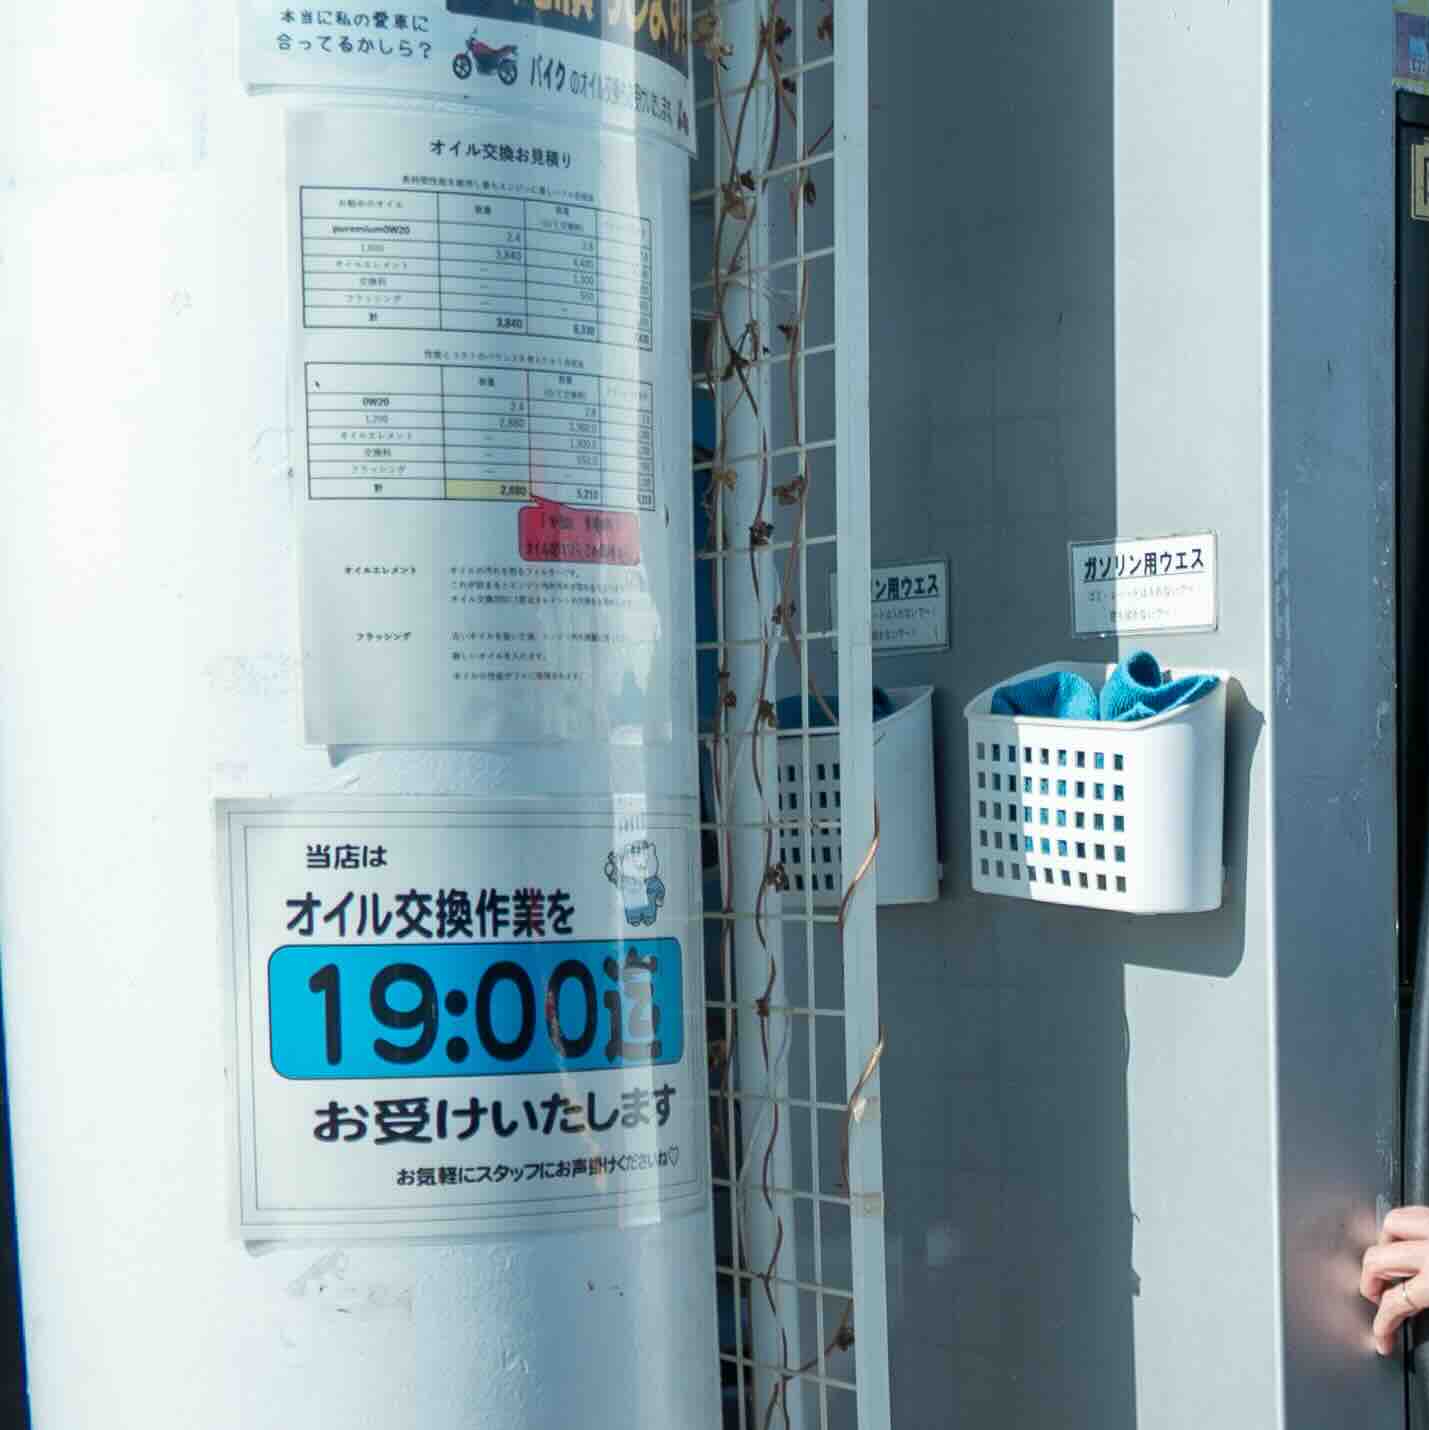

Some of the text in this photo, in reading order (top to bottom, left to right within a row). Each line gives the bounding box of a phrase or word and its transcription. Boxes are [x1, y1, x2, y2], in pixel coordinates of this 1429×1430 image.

[279, 9, 431, 34] 本当に私の愛車に
[429, 137, 573, 169] オイル交換お見積り
[1083, 547, 1205, 581] ガソリン用ウエス
[305, 842, 389, 872] 当店は
[285, 888, 577, 939] オイル交換作業を
[312, 1083, 678, 1147] お受けいたします
